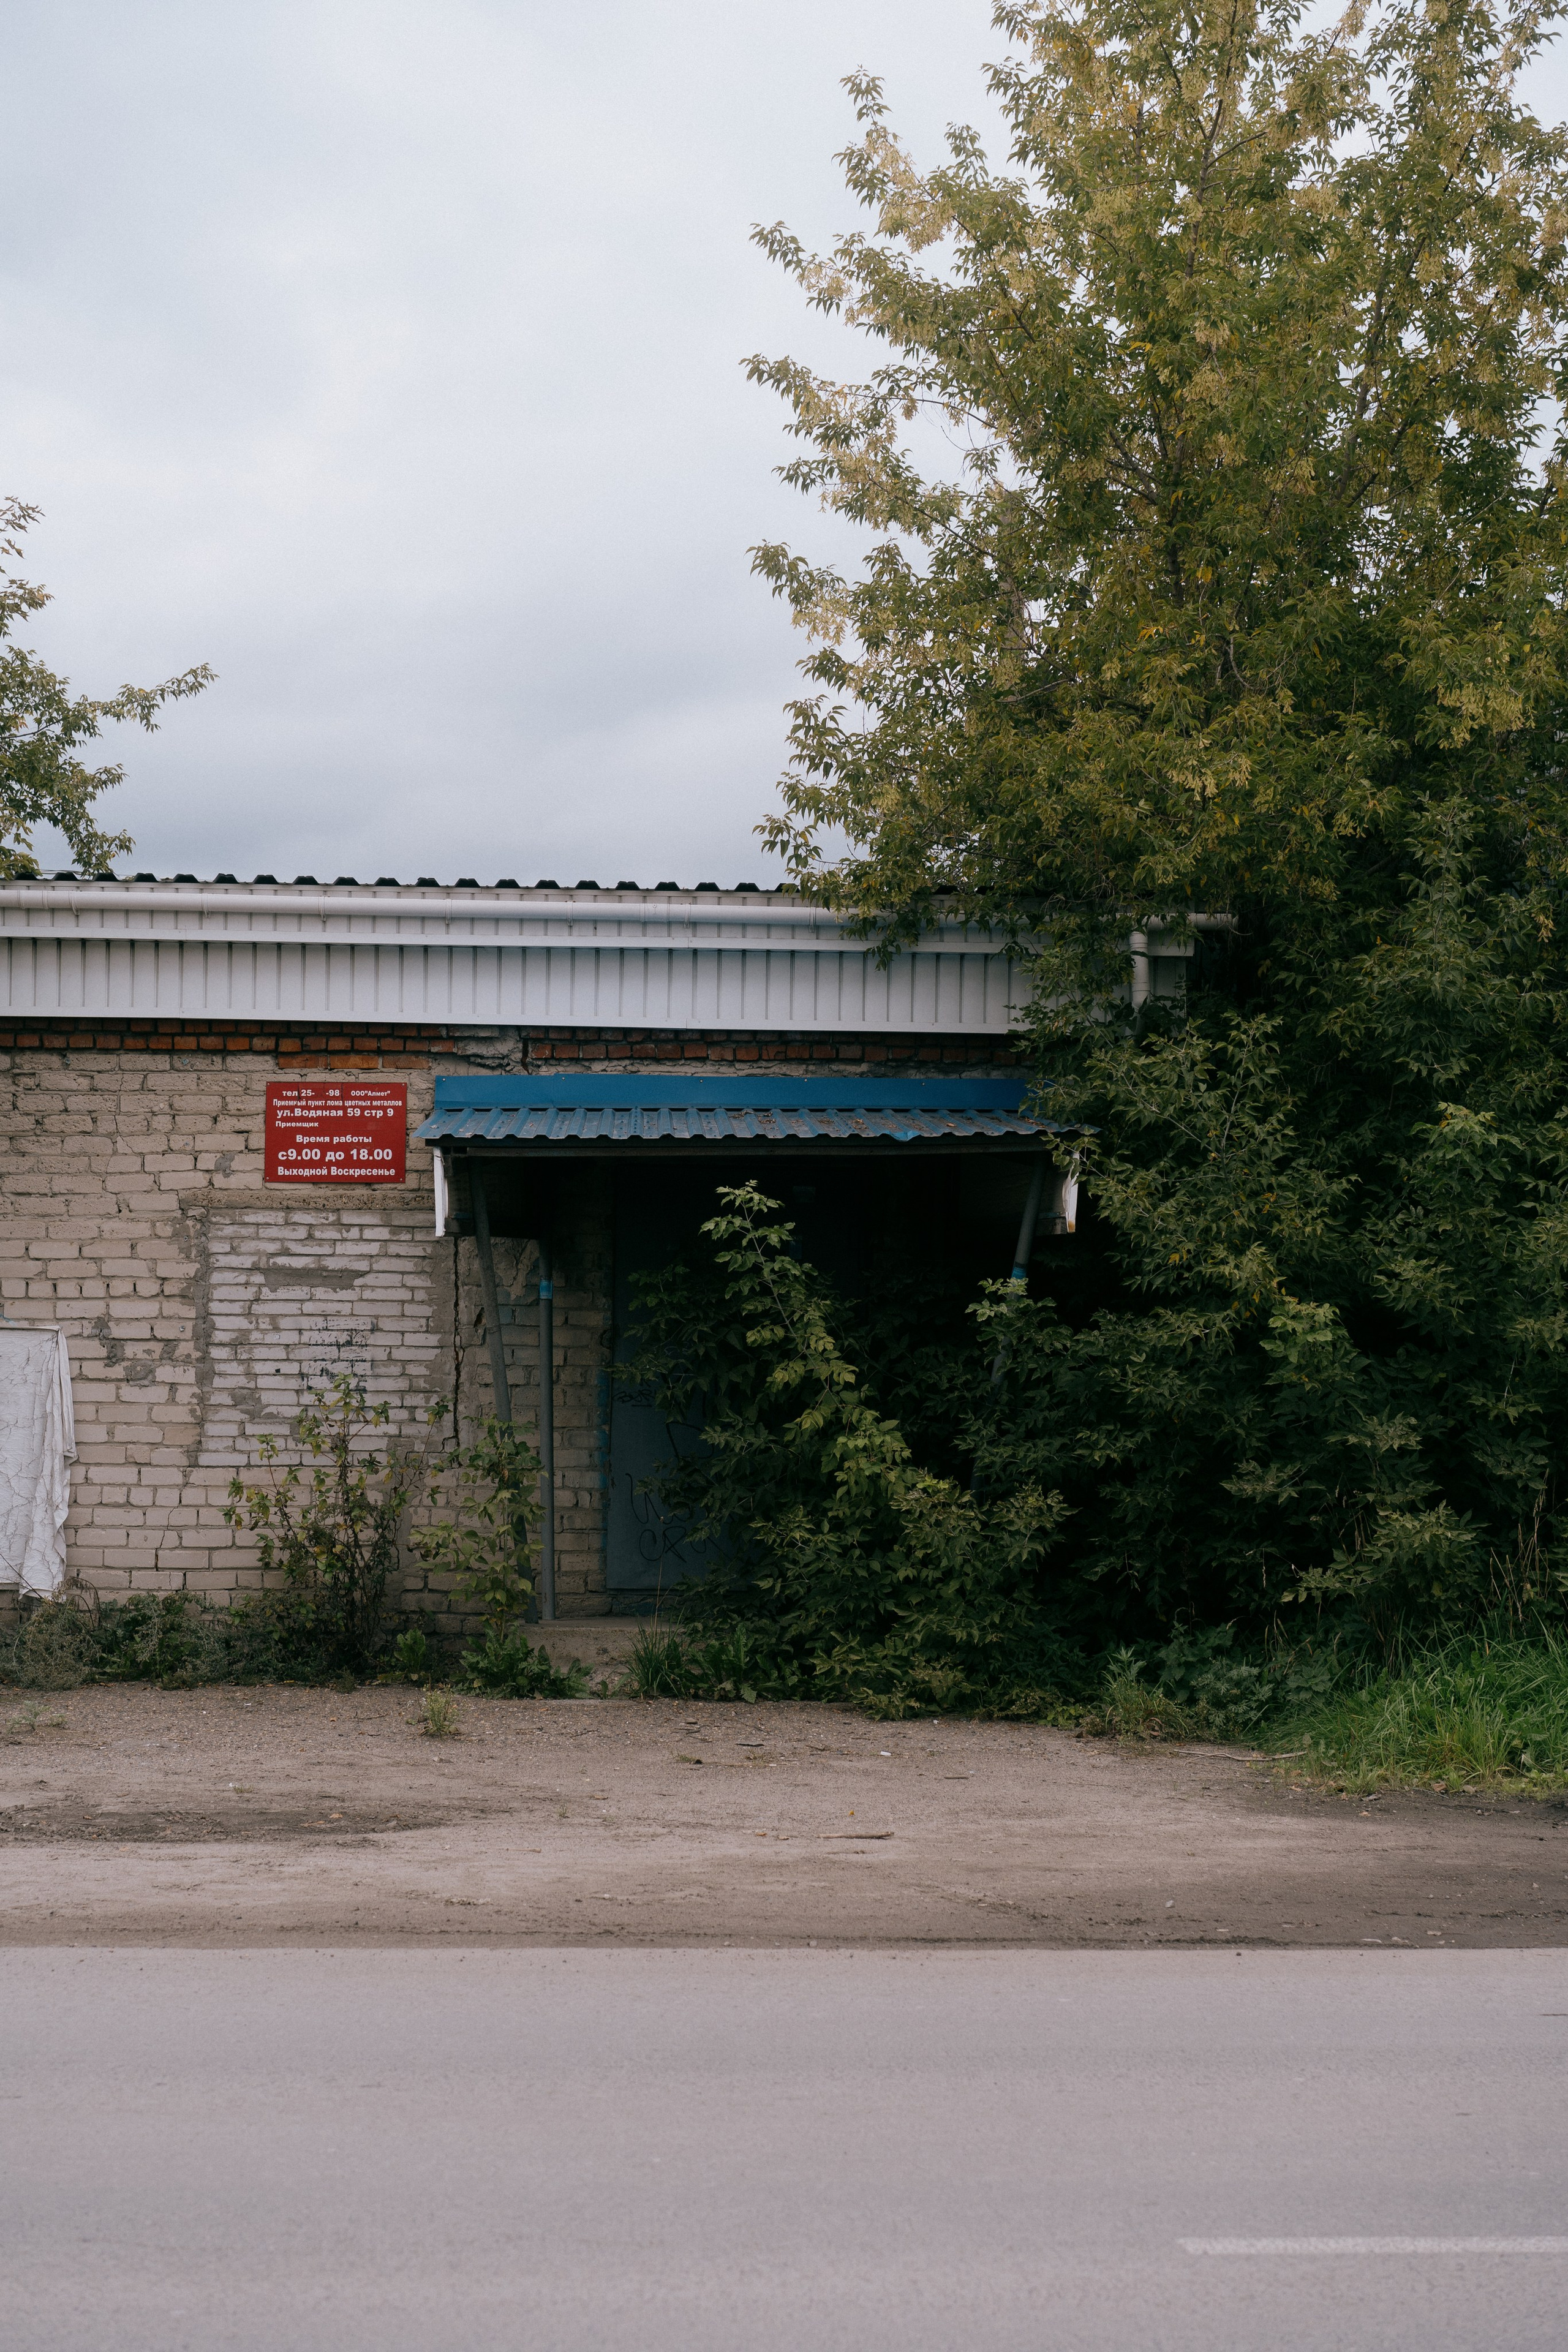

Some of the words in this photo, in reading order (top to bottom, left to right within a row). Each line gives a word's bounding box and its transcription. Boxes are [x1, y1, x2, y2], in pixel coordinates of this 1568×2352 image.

[347, 1108, 361, 1117] 59
[364, 1109, 383, 1118] стр
[387, 1108, 394, 1117] 9
[296, 1135, 330, 1144] Время
[333, 1135, 371, 1144] работы
[278, 1149, 320, 1160] с9.00
[325, 1151, 344, 1162] до
[350, 1149, 393, 1160] 18.00
[277, 1166, 328, 1177] Выходной
[331, 1167, 395, 1177] Воскресенье
